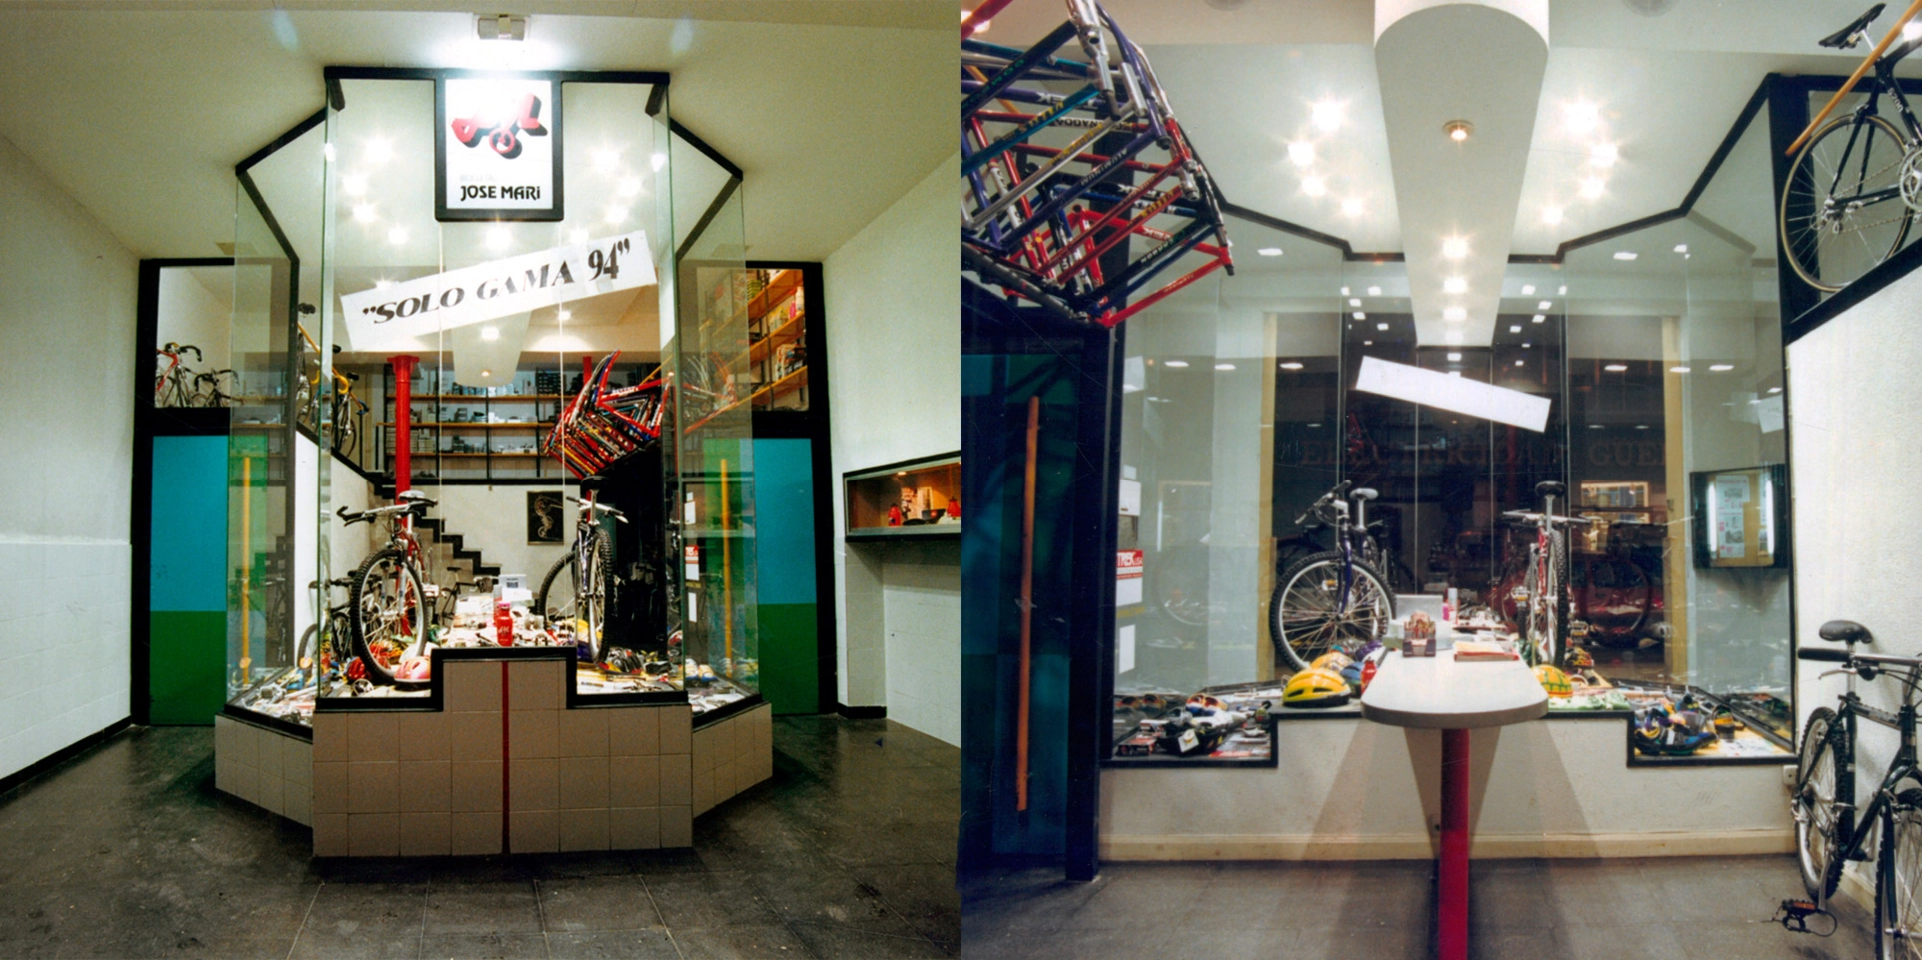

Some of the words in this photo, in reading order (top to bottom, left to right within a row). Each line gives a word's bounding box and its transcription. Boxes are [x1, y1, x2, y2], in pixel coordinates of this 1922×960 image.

[1035, 91, 1100, 110] TEK
[460, 185, 497, 201] JOSE
[476, 259, 575, 301] GAMA
